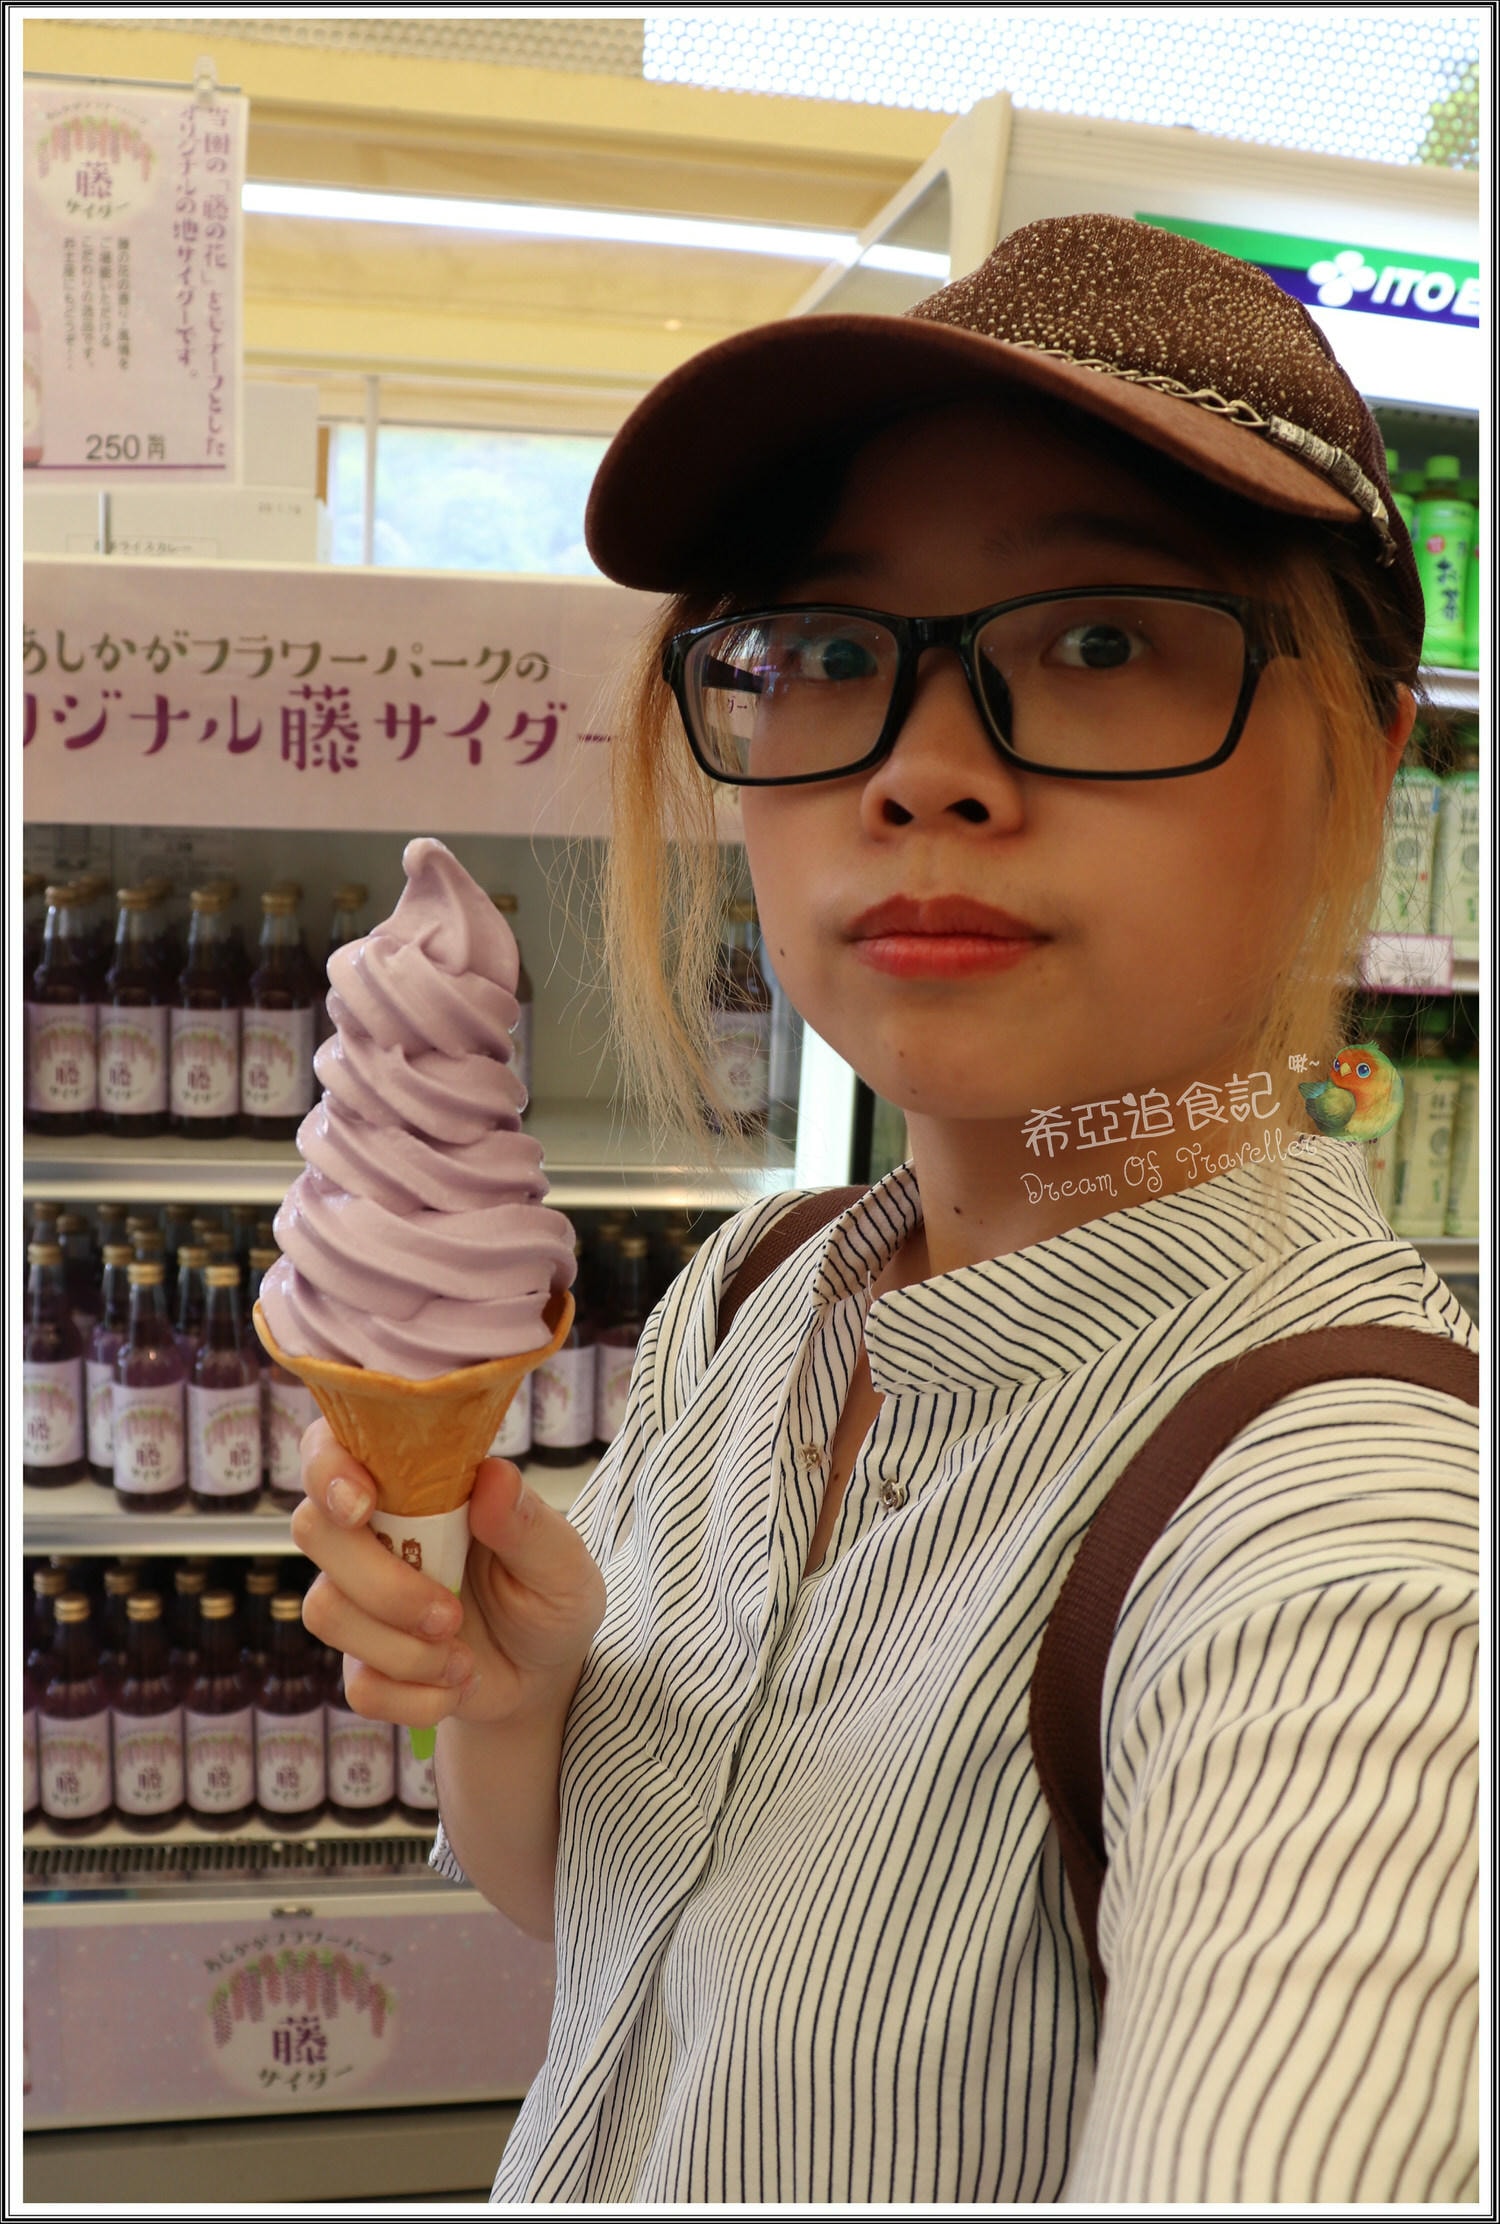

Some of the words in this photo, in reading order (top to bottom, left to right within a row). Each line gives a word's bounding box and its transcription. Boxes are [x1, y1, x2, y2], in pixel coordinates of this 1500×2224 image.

[76, 160, 113, 198] 藤
[23, 624, 549, 684] あしかがフラワーパークの
[272, 2016, 328, 2066] 藤
[258, 2065, 354, 2092] サイダー
